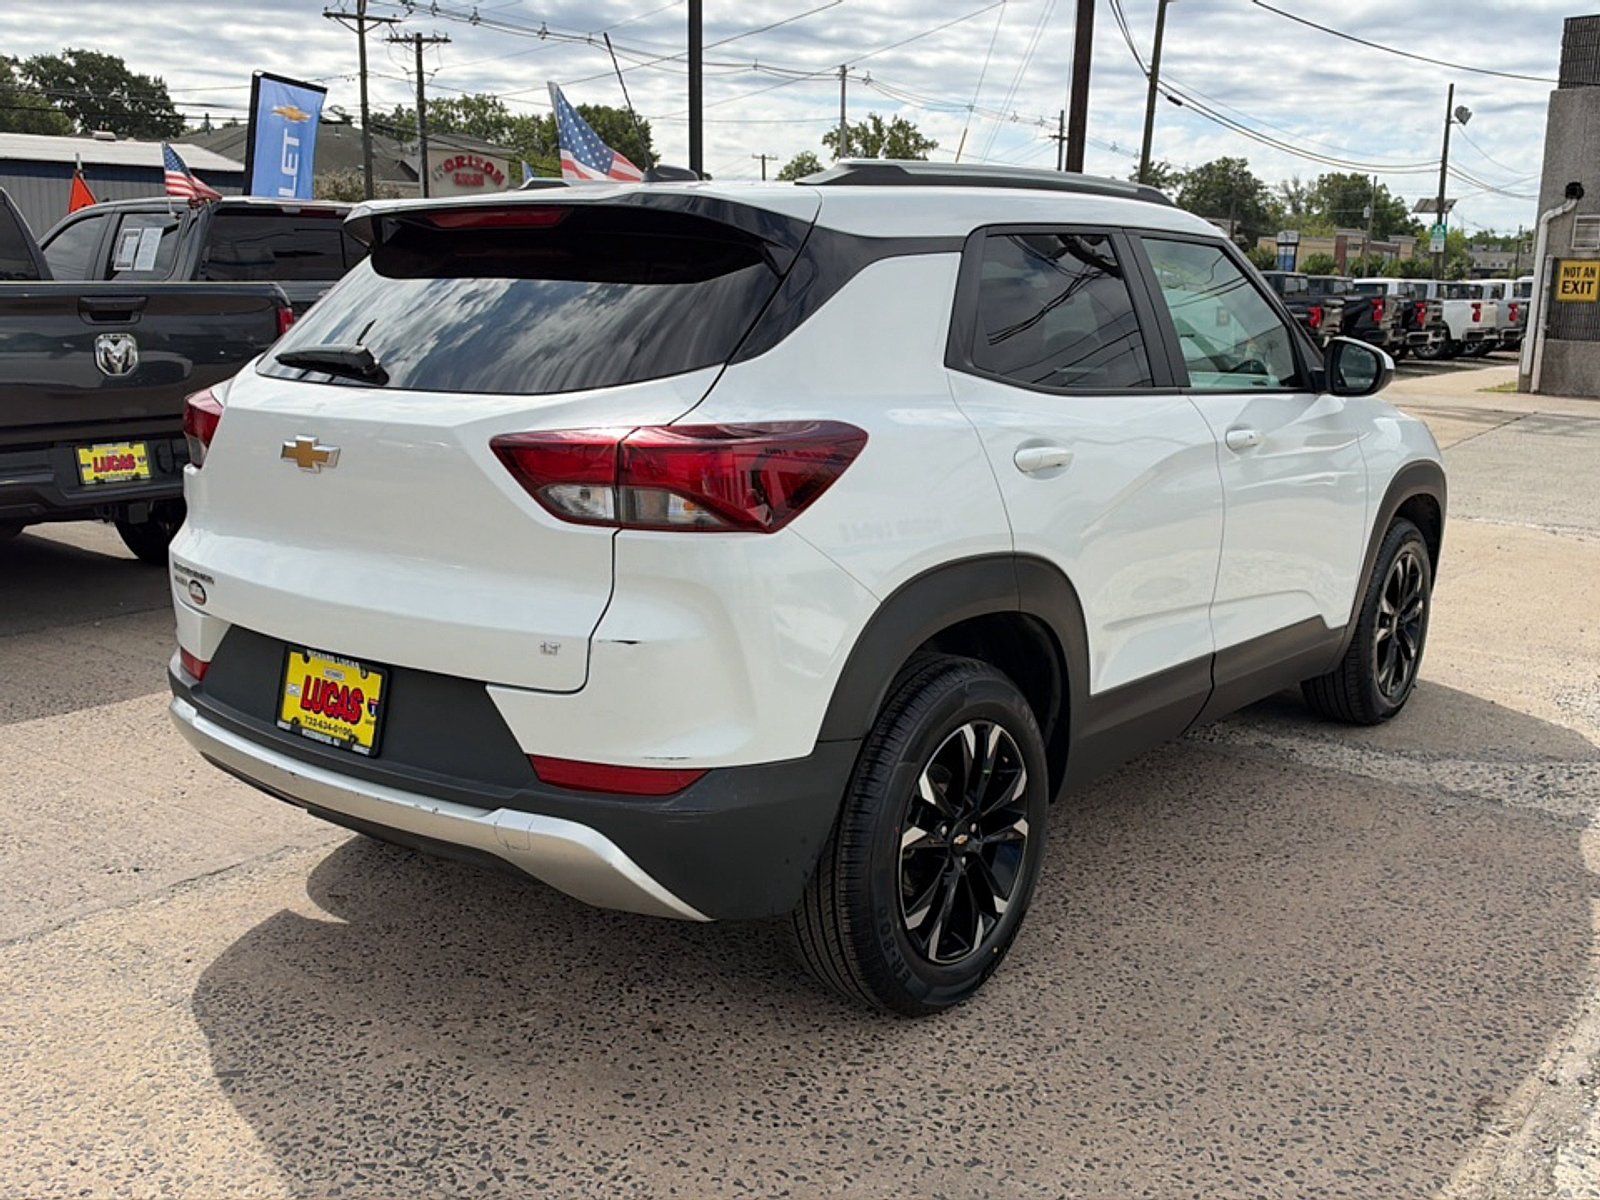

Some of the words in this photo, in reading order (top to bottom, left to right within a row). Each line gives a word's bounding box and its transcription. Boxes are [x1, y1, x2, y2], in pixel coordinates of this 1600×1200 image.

[1563, 266, 1581, 278] NOT
[1584, 266, 1597, 278] AN
[1562, 280, 1594, 295] EXIT
[93, 453, 136, 472] LUCAS
[300, 674, 364, 725] LUCAS
